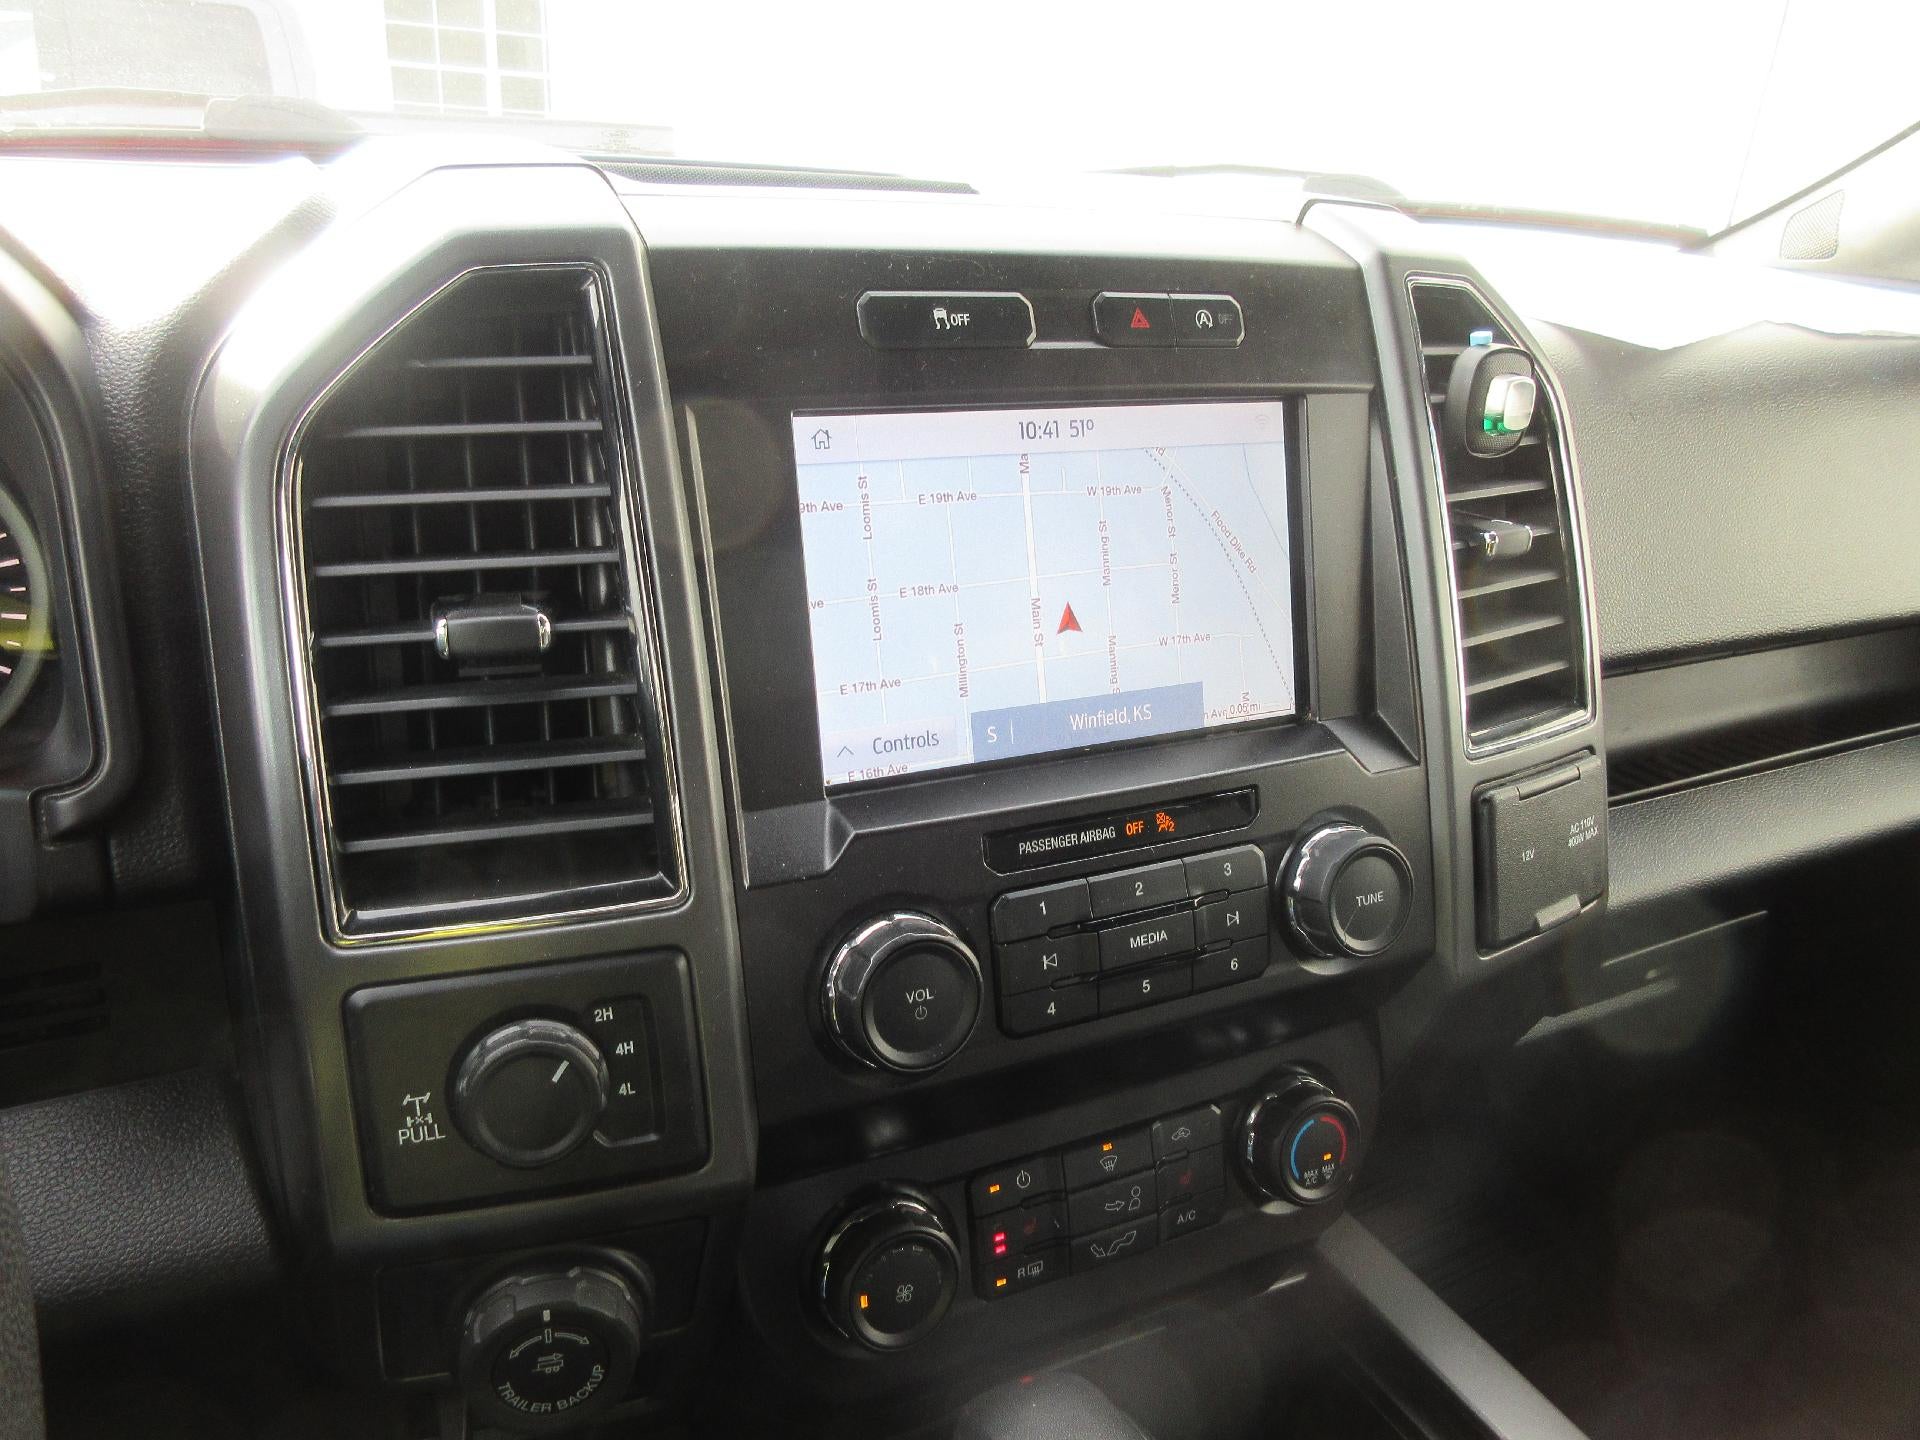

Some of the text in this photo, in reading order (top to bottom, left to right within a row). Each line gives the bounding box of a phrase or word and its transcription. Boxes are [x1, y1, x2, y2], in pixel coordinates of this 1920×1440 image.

[950, 313, 970, 327] OFF
[1218, 313, 1233, 325] OFF
[1019, 420, 1059, 440] 10:41
[918, 490, 977, 505] E 19th Ave
[1086, 484, 1142, 496] W 19th Ave
[821, 500, 843, 512] Ave
[858, 475, 873, 540] Loomis St
[1167, 524, 1176, 538] St
[1210, 510, 1257, 574] Flood Dike Rd
[1098, 519, 1112, 586] Manning St
[1169, 551, 1178, 565] St
[899, 583, 959, 598] E 18th Ave
[867, 578, 882, 641] Loomis St
[1030, 597, 1044, 647] Main St
[1158, 633, 1211, 647] W 17th Ave
[954, 622, 968, 698] Millington St
[1108, 635, 1119, 685] Manning
[840, 678, 901, 696] E 17th Ave
[1230, 701, 1261, 715] 0.05 mi
[1070, 703, 1152, 731] Winfield, KS
[987, 726, 997, 743] S
[873, 730, 940, 755] Controls
[848, 764, 908, 783] E 16th Ave
[1018, 820, 1145, 855] PASSENGER AIRBAG OFF
[1521, 848, 1535, 862] 12V
[1223, 863, 1232, 876] 3
[1134, 881, 1143, 896] 2
[1356, 890, 1385, 907] TUNE
[1039, 901, 1047, 915] 1
[1130, 930, 1168, 949] MEDIA
[1230, 957, 1238, 970] 6
[1142, 979, 1150, 993] 5
[905, 988, 935, 1004] VOL
[594, 1006, 614, 1023] 2H
[1047, 1001, 1056, 1015] 4
[615, 1041, 634, 1056] 4H
[618, 1082, 636, 1096] 4L
[398, 1124, 446, 1145] PULL
[1176, 1210, 1196, 1225] A/C
[498, 1364, 606, 1414] TRAILER BACKUP
